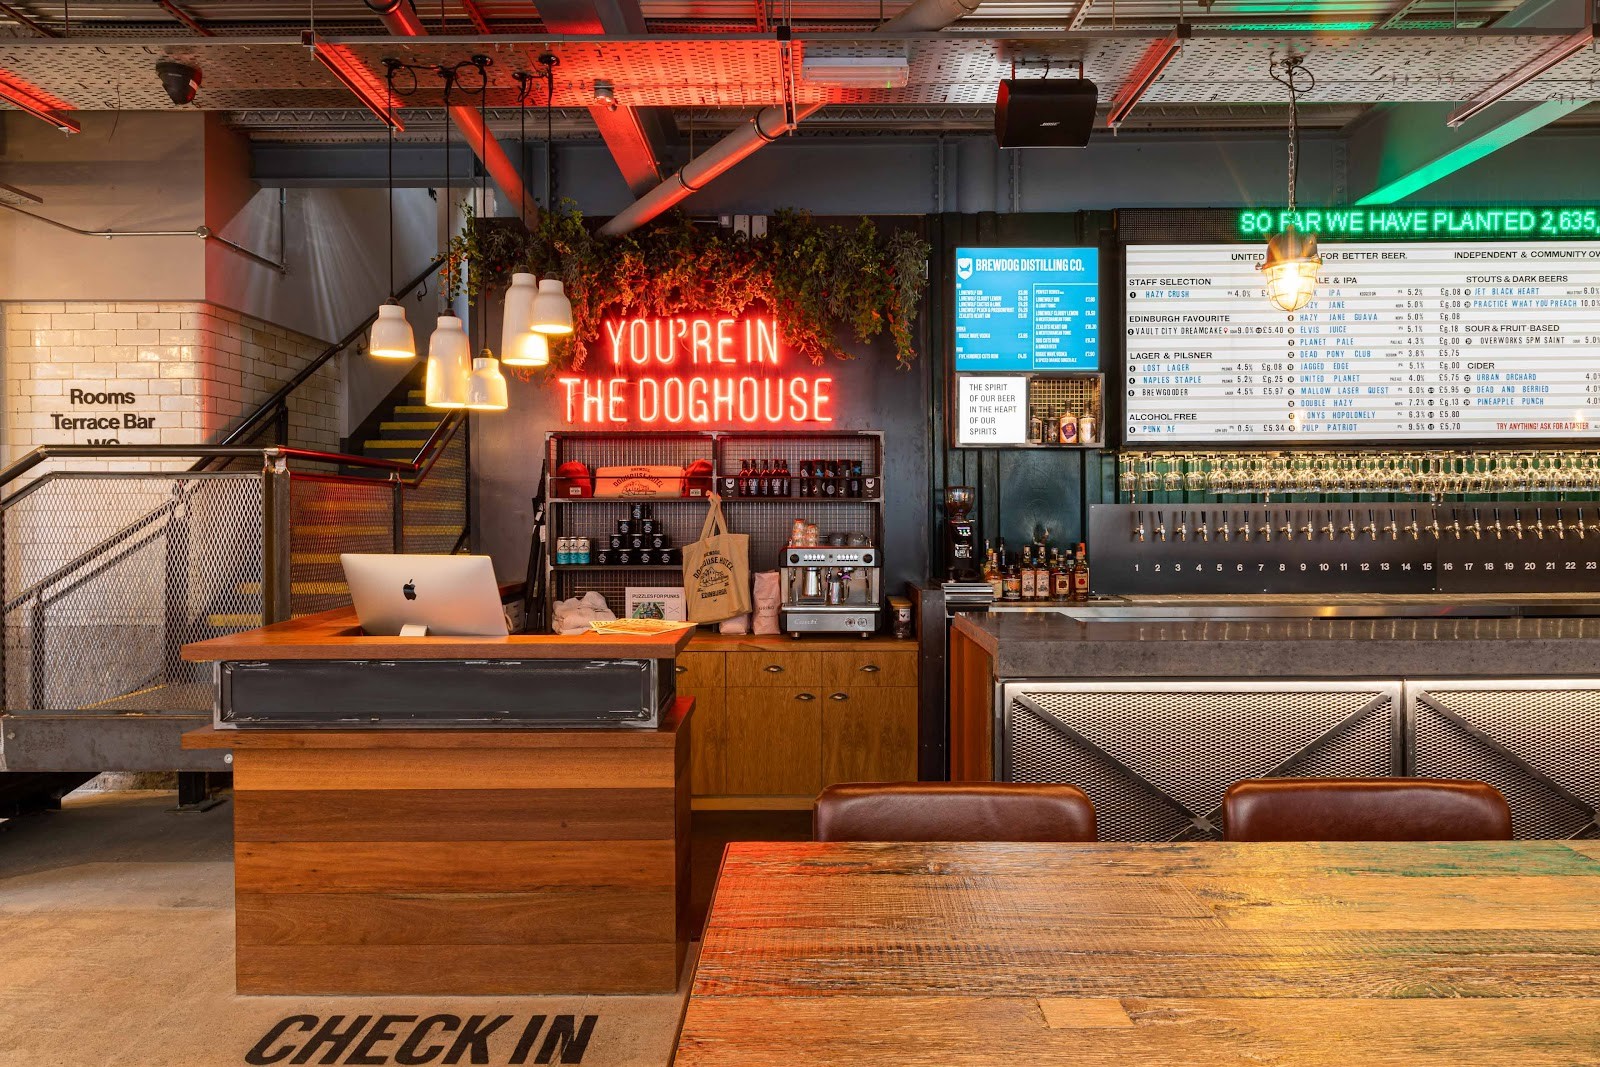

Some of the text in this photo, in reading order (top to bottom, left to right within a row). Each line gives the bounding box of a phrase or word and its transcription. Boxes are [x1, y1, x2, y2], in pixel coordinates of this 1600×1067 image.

[1241, 212, 1271, 232] SO
[1280, 212, 1321, 232] FAR
[1326, 212, 1364, 231] WE
[1369, 212, 1427, 231] HAVE
[1434, 212, 1535, 231] PLANTED
[1231, 253, 1265, 261] UNITED
[1320, 252, 1339, 260] FOR
[1342, 252, 1378, 260] BETTER
[1454, 251, 1517, 259] INDEPENDENT
[1530, 250, 1587, 258] COMMUNITY
[975, 258, 1085, 272] BREWDOG DISTILLING CO.
[1129, 278, 1211, 286] STAFF SELECTION
[1512, 275, 1537, 283] DARK
[1145, 290, 1164, 298] HAZY
[1168, 290, 1190, 298] CRUSH
[1328, 288, 1341, 296] IPA
[1474, 288, 1486, 296] JET
[1517, 287, 1540, 295] HEART
[1328, 301, 1345, 309] JANE
[1473, 300, 1508, 308] PRACTICE
[1512, 300, 1533, 308] WHAT
[1550, 299, 1577, 307] PREACH
[1129, 315, 1180, 323] EDINBURGH
[1299, 313, 1318, 321] HAZY
[1329, 313, 1346, 321] JANE
[1135, 327, 1159, 335] VAULT
[1161, 327, 1178, 335] CITY
[1181, 326, 1223, 335] DREAMCAKE
[1329, 325, 1347, 333] JUICE
[606, 318, 778, 364] YOU'RE IN
[1300, 338, 1354, 346] PLANET PALE
[1480, 337, 1523, 345] OVERWORKS
[1543, 336, 1565, 344] SAINT
[1130, 352, 1160, 360] LAGER
[1163, 352, 1171, 360] &
[1300, 350, 1318, 358] DEAD
[1326, 350, 1345, 358] PONY
[1142, 364, 1161, 372] LOST
[1167, 364, 1190, 372] LAGER
[1333, 362, 1349, 370] EDGE
[1467, 362, 1495, 370] CIDER
[1143, 376, 1170, 384] NAPLES
[1174, 376, 1202, 384] STAPLE
[1300, 374, 1360, 383] UNITED PLANET
[1505, 373, 1537, 381] ORCHARD
[969, 383, 1008, 391] THE SPIRIT
[1367, 386, 1389, 394] QUEST
[1476, 386, 1494, 394] DEAD
[1522, 385, 1549, 393] BERRIED
[1142, 388, 1188, 396] BREWGOODER
[70, 388, 136, 405] Rooms
[559, 376, 833, 423] THE DOGHOUSE
[969, 394, 1016, 402] OF OUR BEER
[1300, 399, 1353, 407] DOUBLE HAZY
[1521, 397, 1544, 405] PUNCH
[969, 405, 1017, 413] IN THE HEART
[1129, 413, 1198, 421] ALCOHOL FREE
[1332, 411, 1376, 419] HOPOLONELY
[50, 413, 156, 430] Terrace Bar
[969, 416, 996, 424] OF OUR
[1142, 425, 1161, 433] PUNK
[1166, 425, 1176, 433] AF
[1302, 424, 1319, 432] PULP
[1496, 422, 1508, 430] TRY
[1509, 422, 1539, 430] ANYTHING!
[1540, 422, 1552, 430] ASK
[1552, 422, 1564, 430] FOR
[969, 427, 997, 436] SPIRITS
[1134, 564, 1139, 572] 1
[1300, 563, 1307, 571] 9
[1319, 563, 1329, 571] 10
[1464, 562, 1473, 570] 17
[1484, 562, 1494, 570] 18
[245, 1014, 599, 1066] CHECK IN
